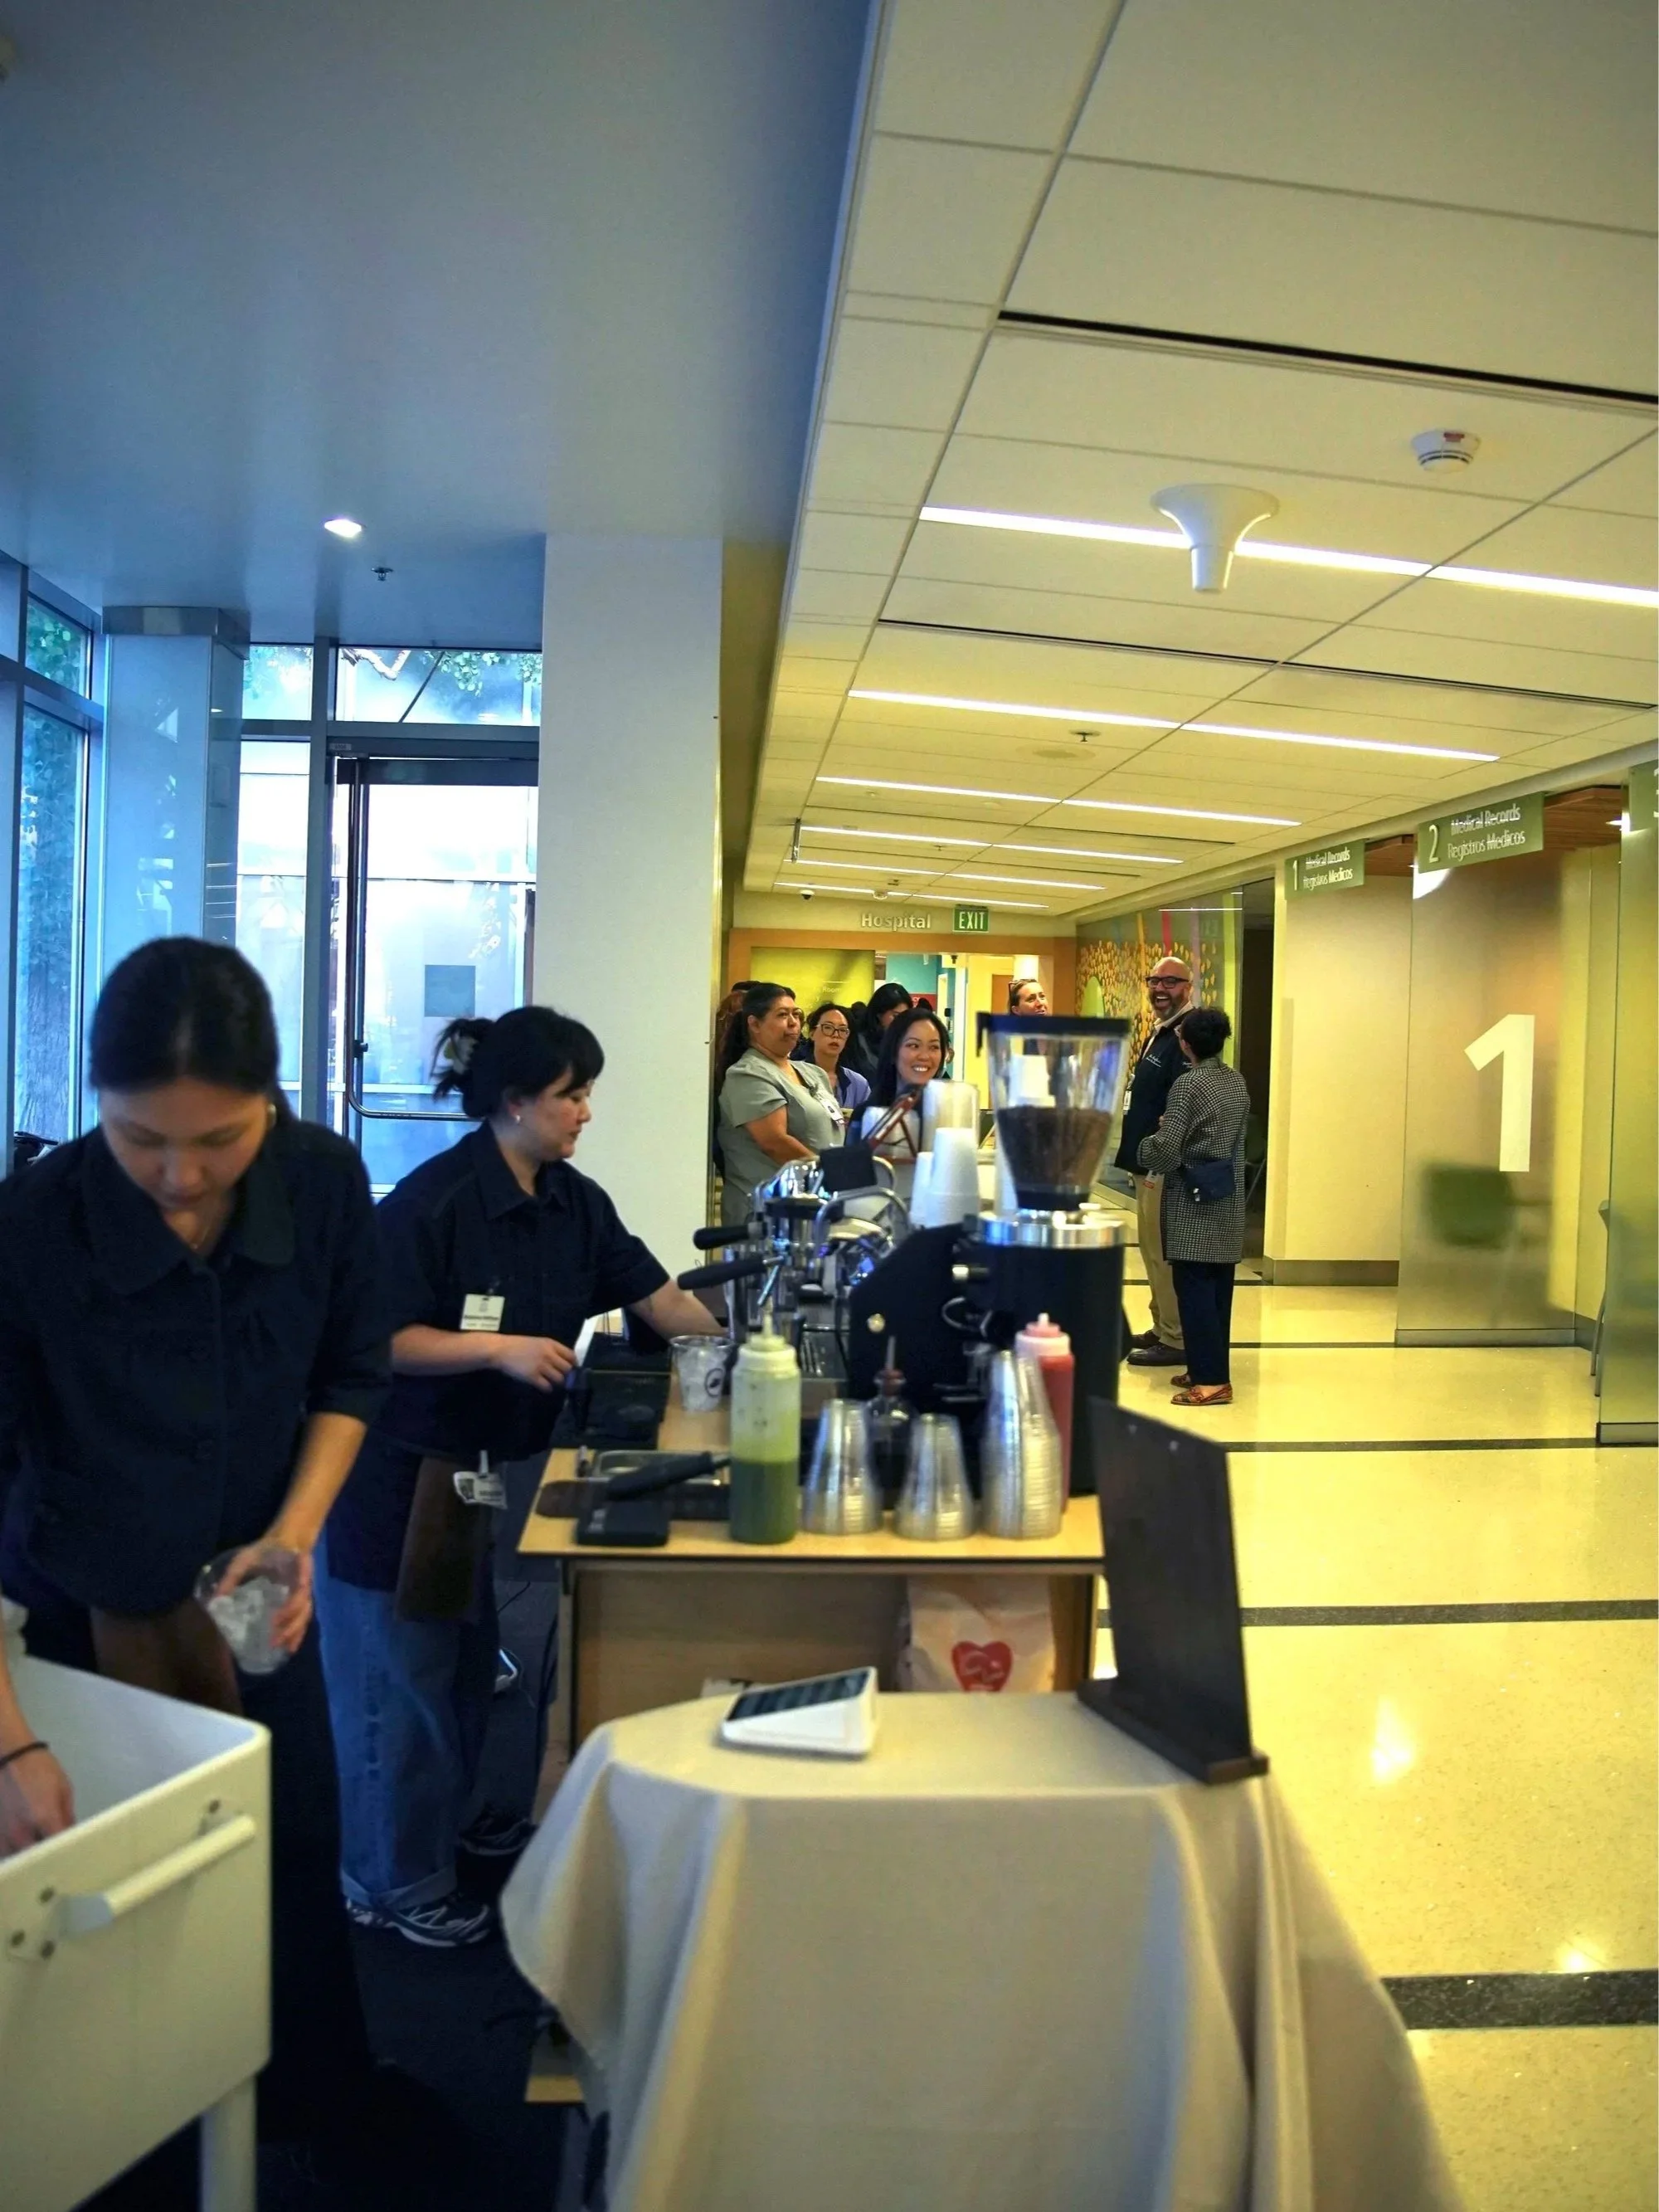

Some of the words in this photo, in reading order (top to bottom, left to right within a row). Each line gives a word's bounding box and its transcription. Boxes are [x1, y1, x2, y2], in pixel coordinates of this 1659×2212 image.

[1485, 803, 1521, 827] Records
[1428, 825, 1439, 864] 2
[1447, 839, 1486, 862] Registros
[1293, 860, 1297, 890] 1
[861, 914, 932, 931] Hospital
[958, 911, 985, 929] EXIT
[1464, 1014, 1535, 1172] 1
